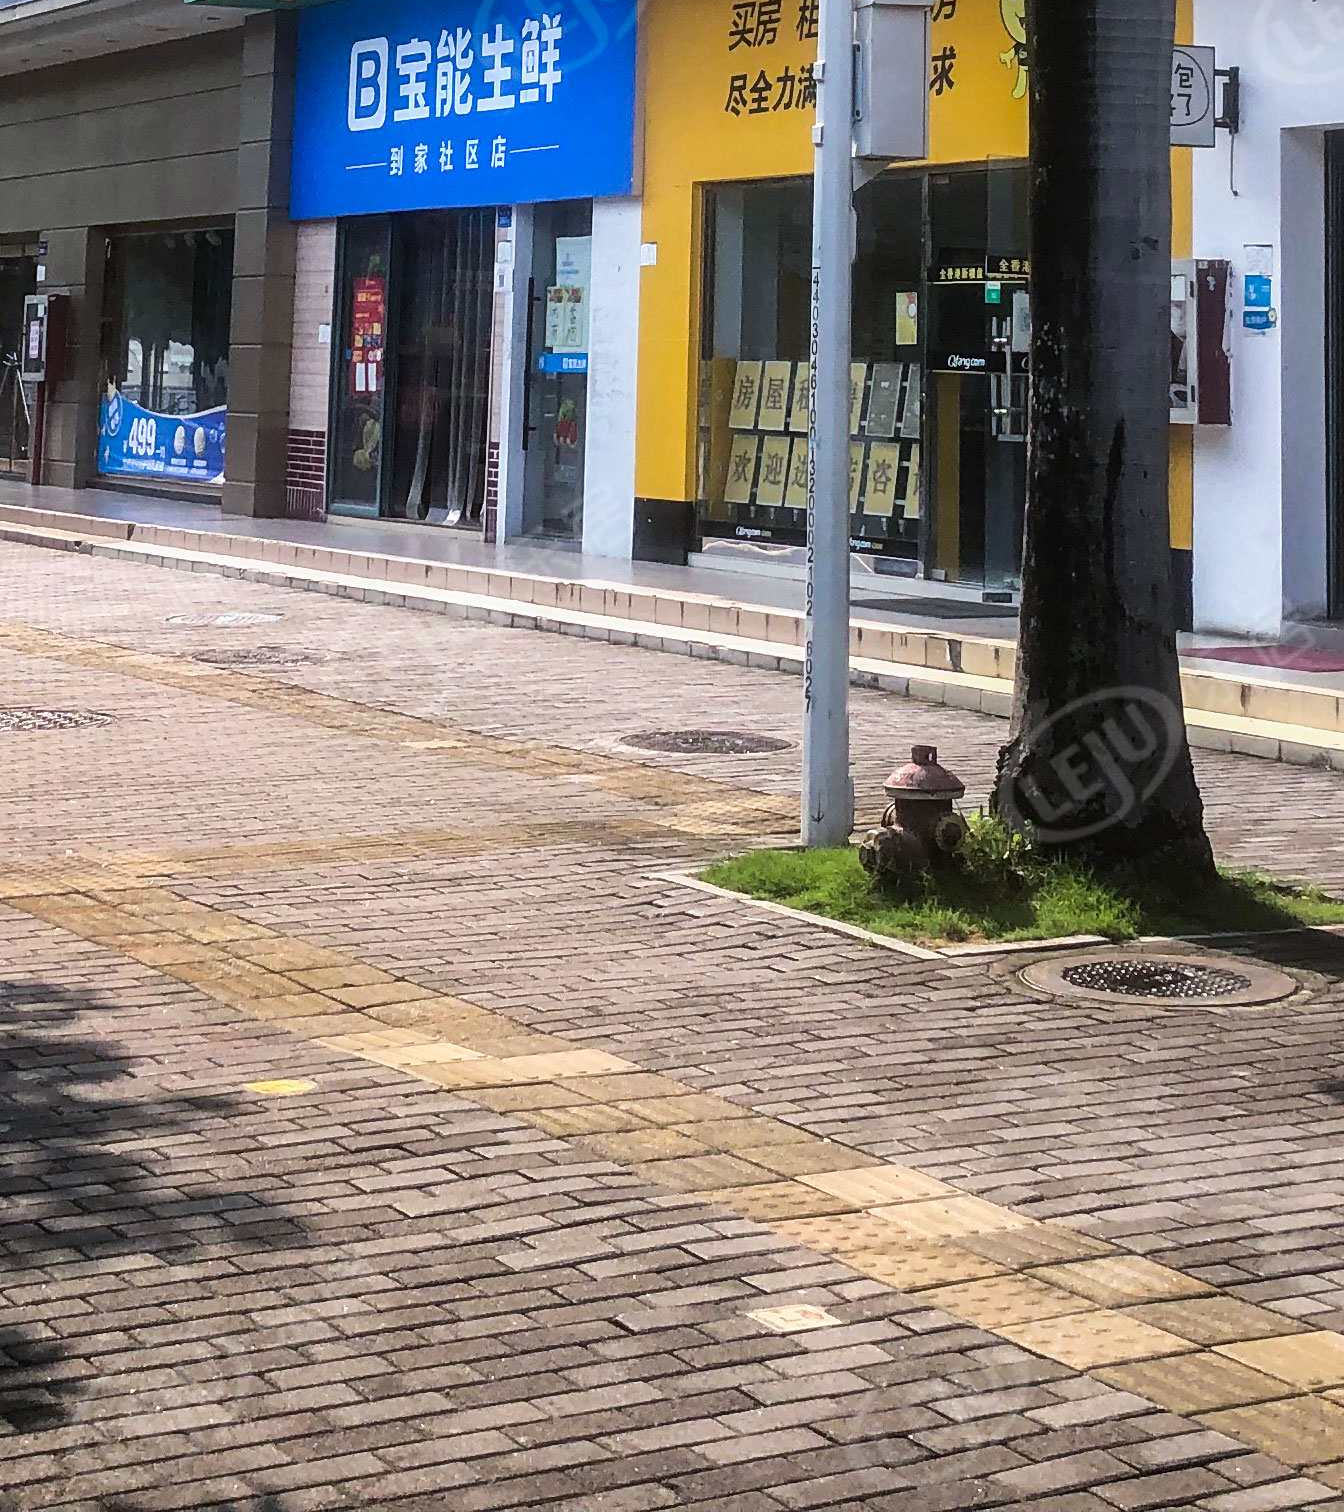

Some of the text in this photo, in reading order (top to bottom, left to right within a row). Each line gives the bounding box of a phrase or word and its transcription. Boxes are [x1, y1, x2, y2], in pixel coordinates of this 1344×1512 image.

[393, 13, 563, 122] 宝能生鲜
[389, 134, 508, 176] 到家社区店
